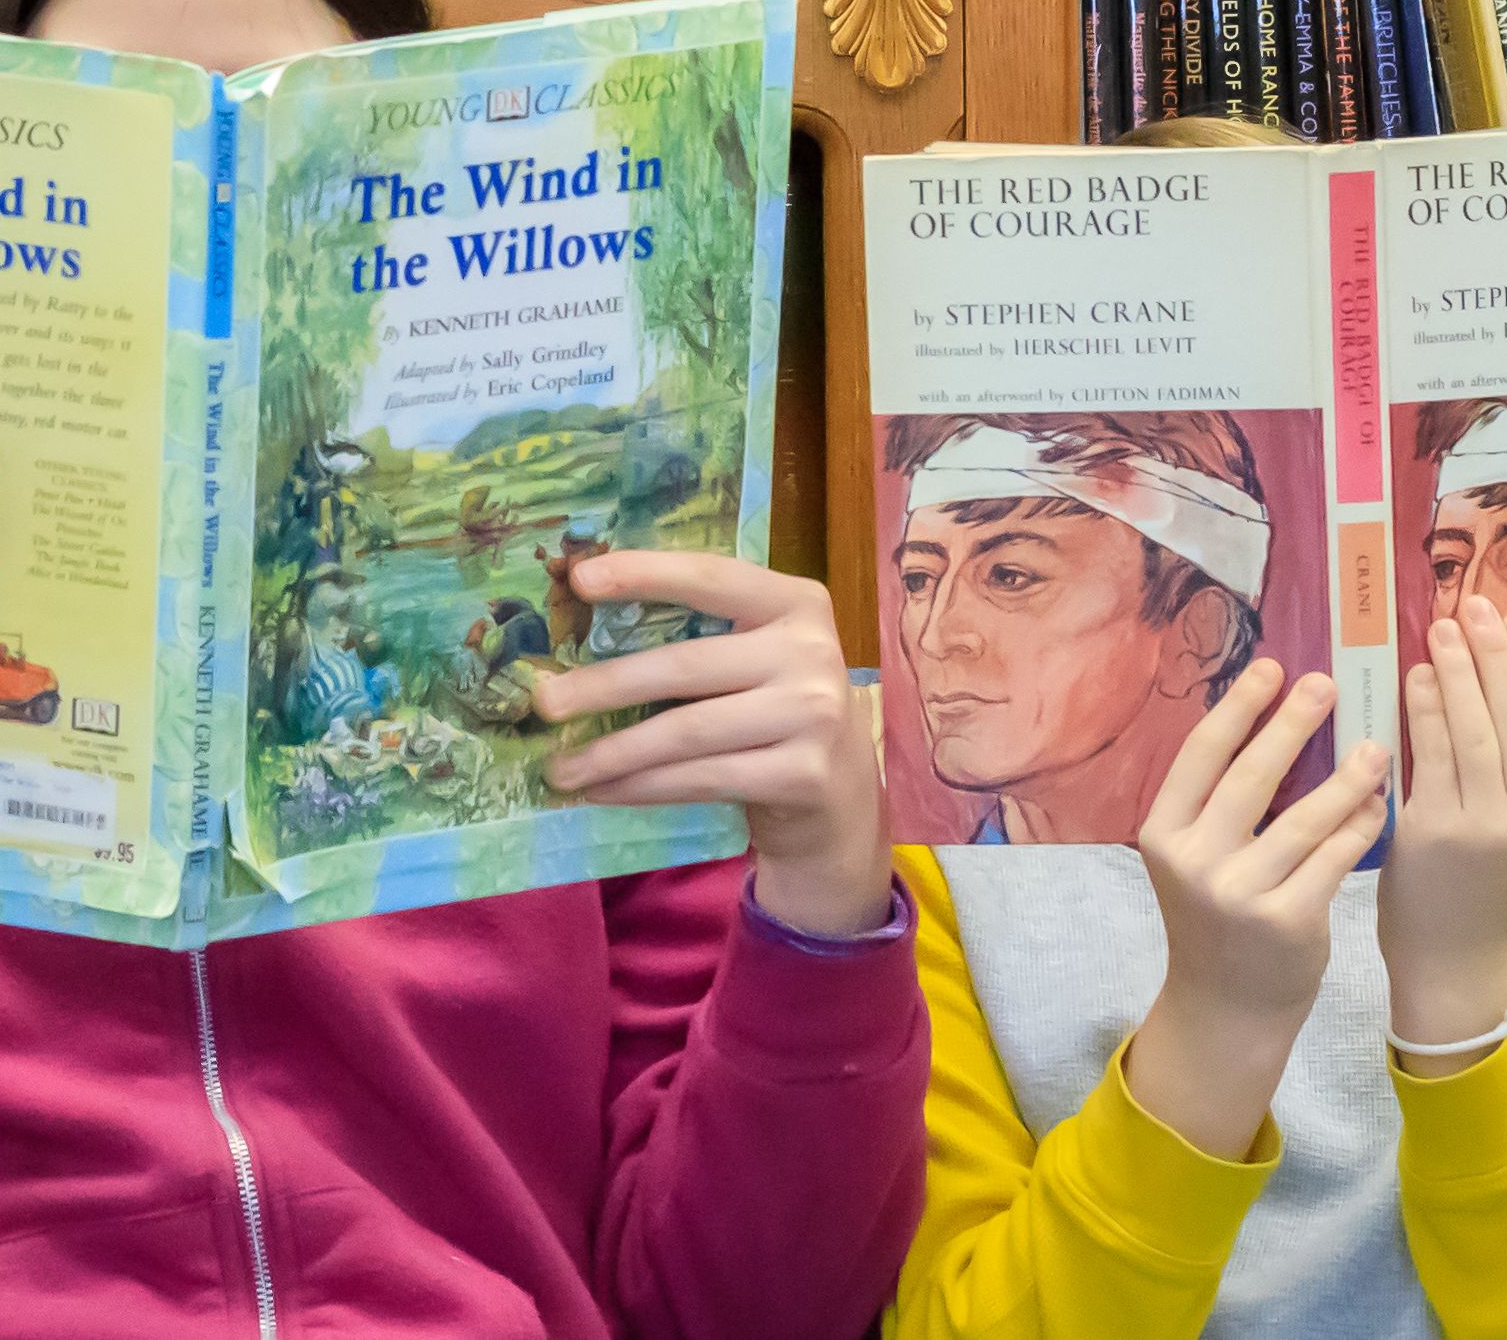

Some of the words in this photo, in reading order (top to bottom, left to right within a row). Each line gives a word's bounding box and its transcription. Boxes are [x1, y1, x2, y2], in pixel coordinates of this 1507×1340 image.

[1225, 59, 1241, 91] OF
[366, 94, 481, 135] YOUNG
[534, 73, 678, 115] CLASSICS
[351, 173, 445, 223] The
[464, 150, 600, 210] Wind
[616, 146, 663, 193] in
[910, 178, 983, 206] THE
[1000, 177, 1072, 205] RED
[1088, 174, 1210, 203] BADGE
[1407, 162, 1474, 192] THE
[44, 180, 88, 228] in
[1408, 198, 1450, 226] OF
[910, 211, 956, 240] OF
[970, 209, 1152, 238] COURAGE
[351, 244, 428, 293] the
[447, 224, 655, 280] Willows
[1355, 225, 1369, 264] THE
[409, 310, 510, 338] KENNETH
[518, 297, 624, 324] GRAHAME
[914, 309, 934, 330] by
[945, 302, 1075, 327] STEPHEN
[1091, 300, 1195, 323] CRANE
[1412, 297, 1431, 318] by
[482, 350, 522, 370] Sally
[532, 340, 608, 365] Grindley
[915, 343, 983, 358] illustrated
[989, 343, 1005, 358] by
[1014, 338, 1125, 356] HERSCHEL
[1135, 337, 1196, 355] LEVIT
[207, 361, 225, 395] The
[488, 378, 522, 396] Eric
[531, 367, 614, 393] Copeland
[919, 389, 949, 403] with
[977, 388, 1042, 402] afterword
[1049, 388, 1065, 403] by
[1072, 387, 1150, 402] CLIFTON
[1158, 386, 1241, 401] FADIMAN
[205, 402, 223, 451] Wind
[204, 475, 217, 508] the
[201, 514, 221, 589] Willows
[1357, 554, 1372, 617] CRANE
[194, 605, 215, 715] KENNETH
[191, 724, 213, 840] GRAHAME
